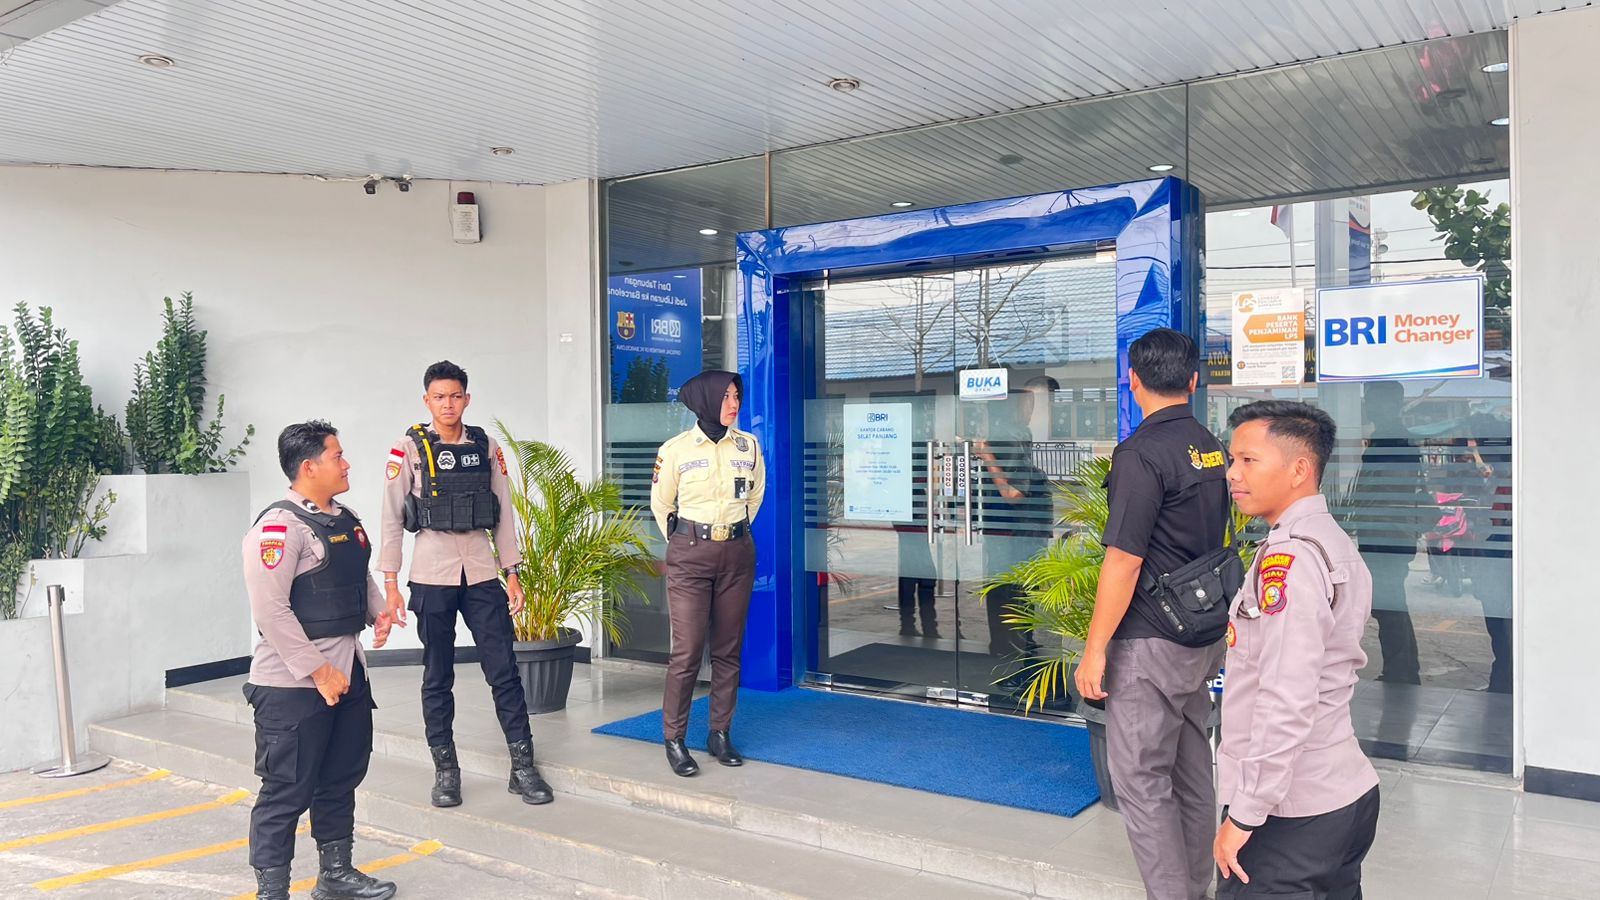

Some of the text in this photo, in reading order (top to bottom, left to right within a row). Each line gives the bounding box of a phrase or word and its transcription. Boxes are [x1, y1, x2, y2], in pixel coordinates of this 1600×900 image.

[1265, 320, 1298, 328] PESERTA
[1248, 327, 1298, 336] PENJAMINAN
[1324, 314, 1460, 347] BRI Money
[1394, 328, 1475, 344] Changer
[967, 376, 1002, 388] BUKA
[875, 413, 889, 421] BRI
